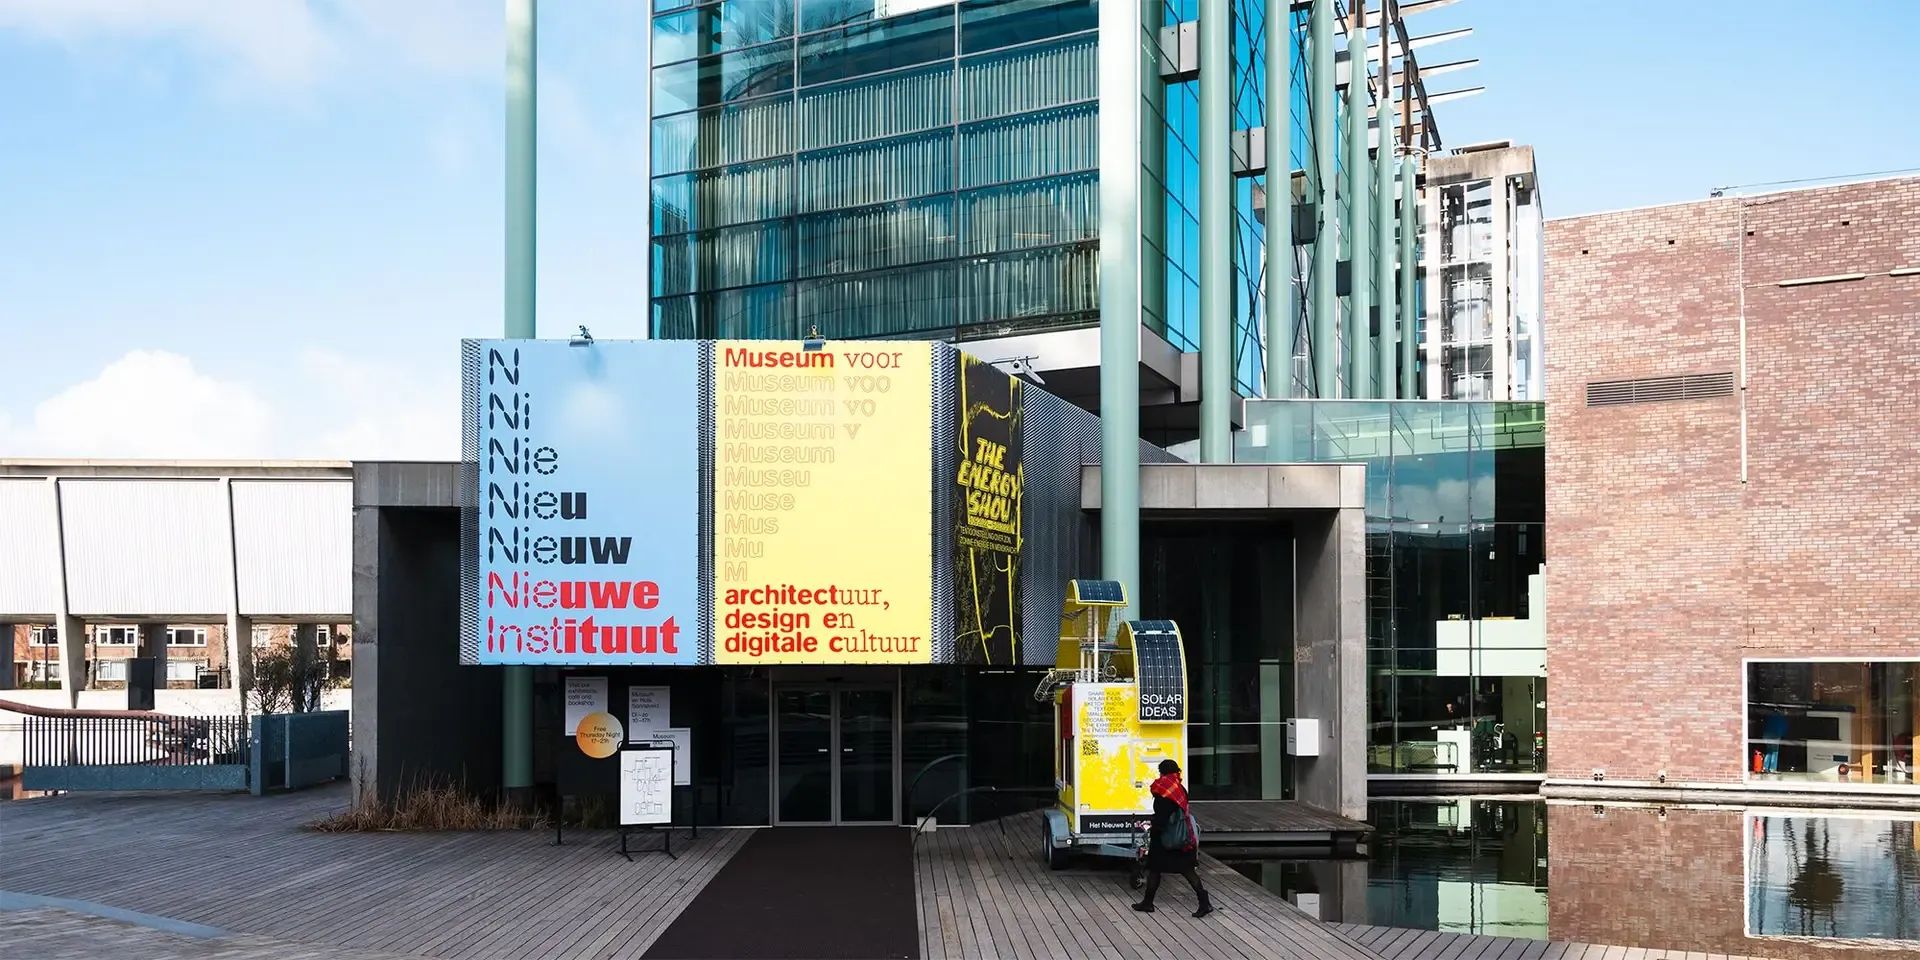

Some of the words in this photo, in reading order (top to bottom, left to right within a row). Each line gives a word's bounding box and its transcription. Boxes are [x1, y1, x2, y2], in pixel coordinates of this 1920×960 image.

[488, 347, 520, 386] N
[725, 348, 835, 368] Museum
[844, 351, 903, 368] voor
[725, 371, 835, 392] Museum
[844, 374, 891, 393] voo
[488, 392, 530, 431] Ni
[725, 395, 835, 416] Museum
[844, 398, 876, 417] vo
[725, 419, 835, 440] Museum
[844, 422, 861, 440] v
[488, 437, 559, 475] Nie
[725, 443, 835, 463] Museum
[976, 436, 1007, 471] THE
[725, 466, 810, 487] Museu
[957, 459, 1019, 500] ENERGY
[488, 481, 587, 520] Nieu
[725, 490, 795, 511] Muse
[968, 489, 1011, 523] SHOW
[725, 514, 778, 534] Mus
[488, 526, 632, 565] Nieuw
[725, 537, 763, 558] Mu
[725, 561, 748, 582] M
[488, 570, 660, 609] Nieuwe
[725, 584, 890, 610] architectuur,
[725, 608, 810, 635] design
[823, 613, 855, 630] en
[487, 615, 680, 654] Instituut
[725, 632, 818, 657] digitale
[828, 632, 921, 654] cultuur
[1141, 694, 1182, 704] SOLAR
[1141, 706, 1177, 717] IDEAS
